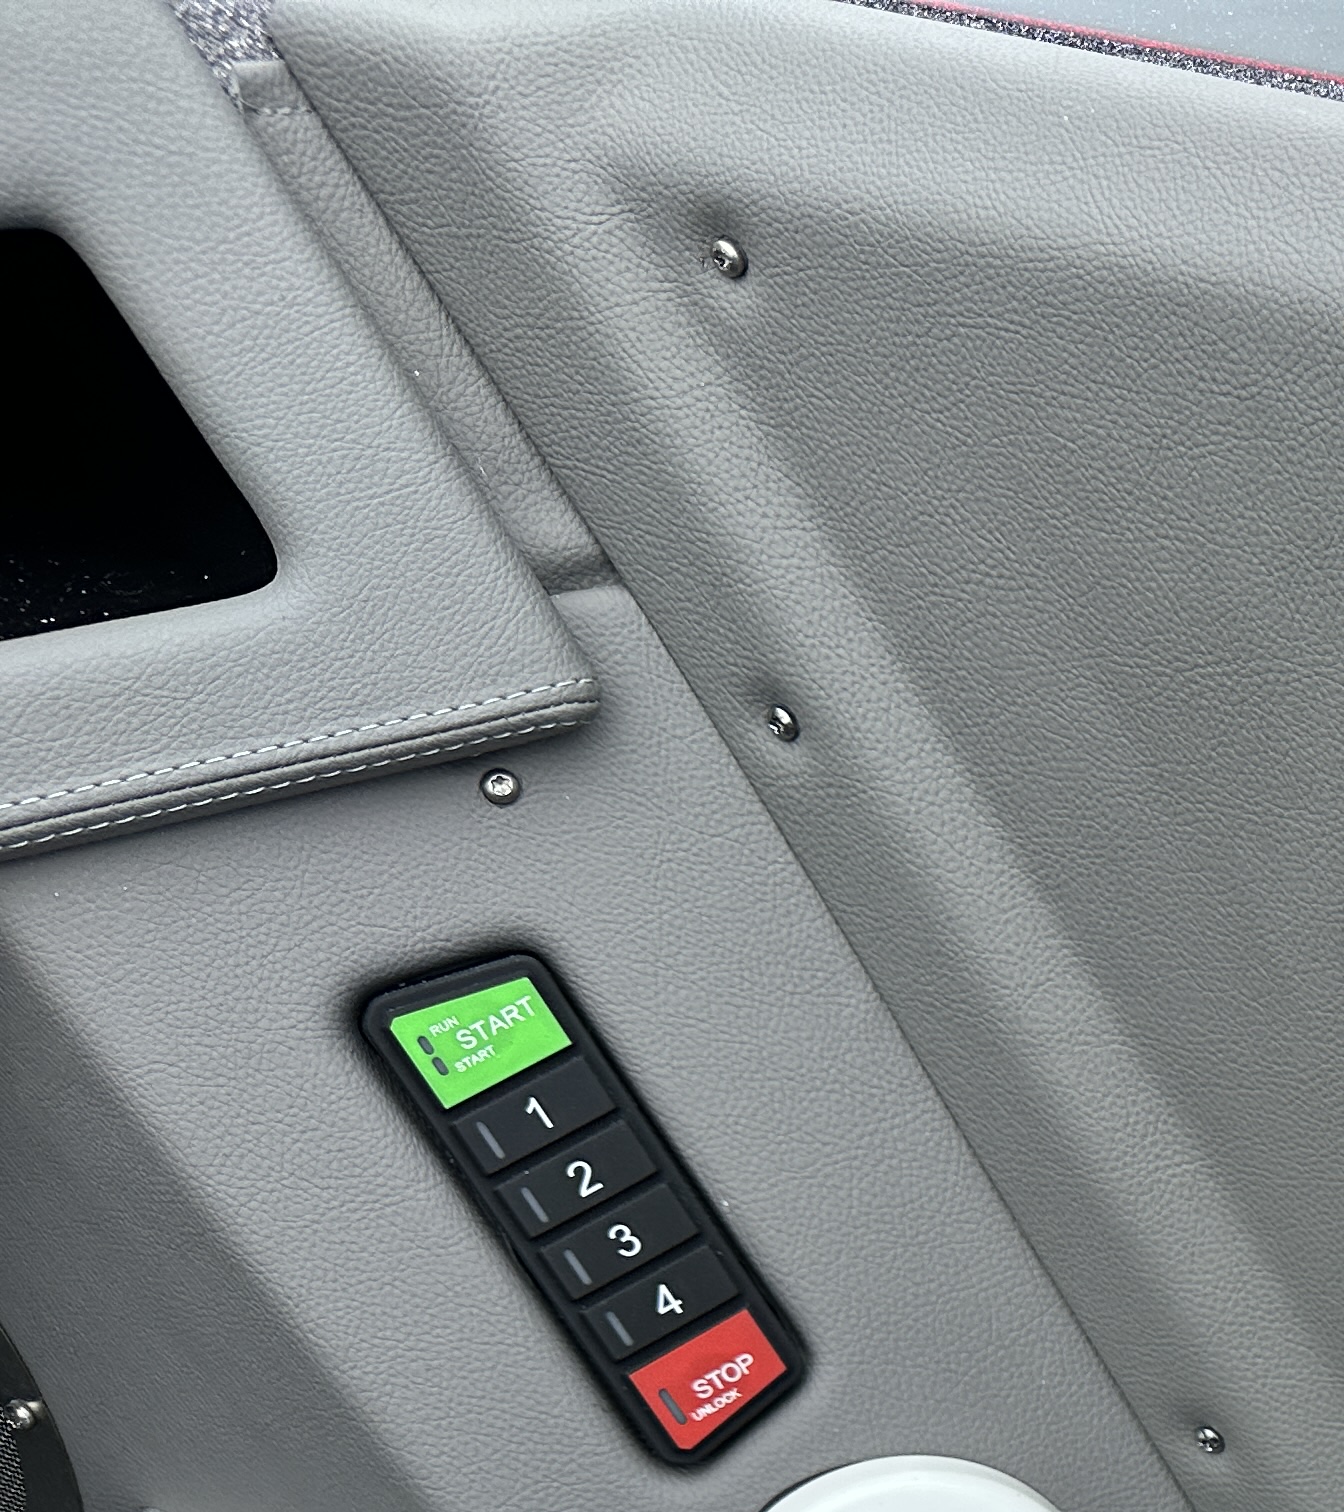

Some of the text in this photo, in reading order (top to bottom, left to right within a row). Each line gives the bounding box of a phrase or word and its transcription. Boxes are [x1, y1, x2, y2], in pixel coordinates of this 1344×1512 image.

[429, 1015, 460, 1037] RUN
[456, 995, 535, 1050] START
[454, 1044, 496, 1073] START
[525, 1096, 554, 1129] 1
[566, 1160, 604, 1198] 2
[608, 1224, 642, 1257] 3
[656, 1284, 683, 1316] 4
[691, 1353, 754, 1398] STOP
[689, 1387, 743, 1421] UNLOCK
